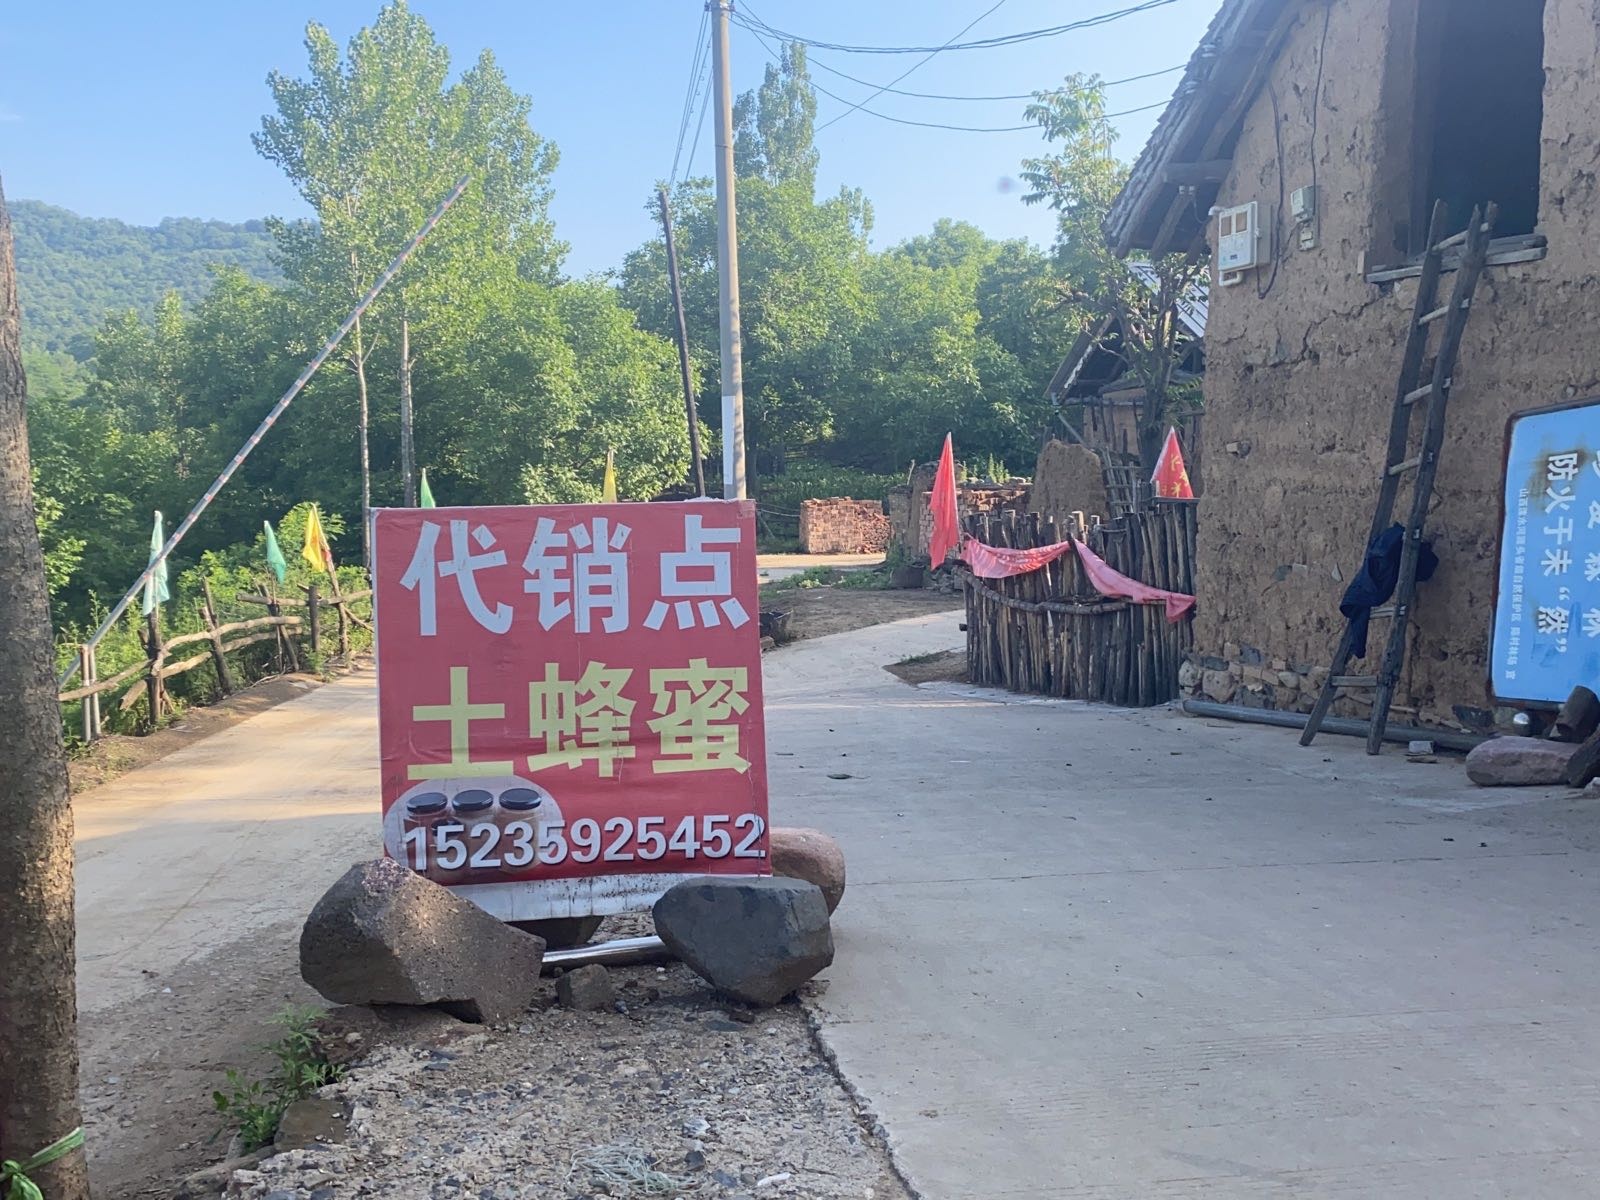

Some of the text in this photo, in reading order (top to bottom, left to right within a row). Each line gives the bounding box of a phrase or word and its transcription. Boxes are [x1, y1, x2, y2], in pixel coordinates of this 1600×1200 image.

[400, 514, 750, 636] 代销点
[407, 658, 751, 780] 土蜂蜜
[404, 813, 767, 871] 15235925452
